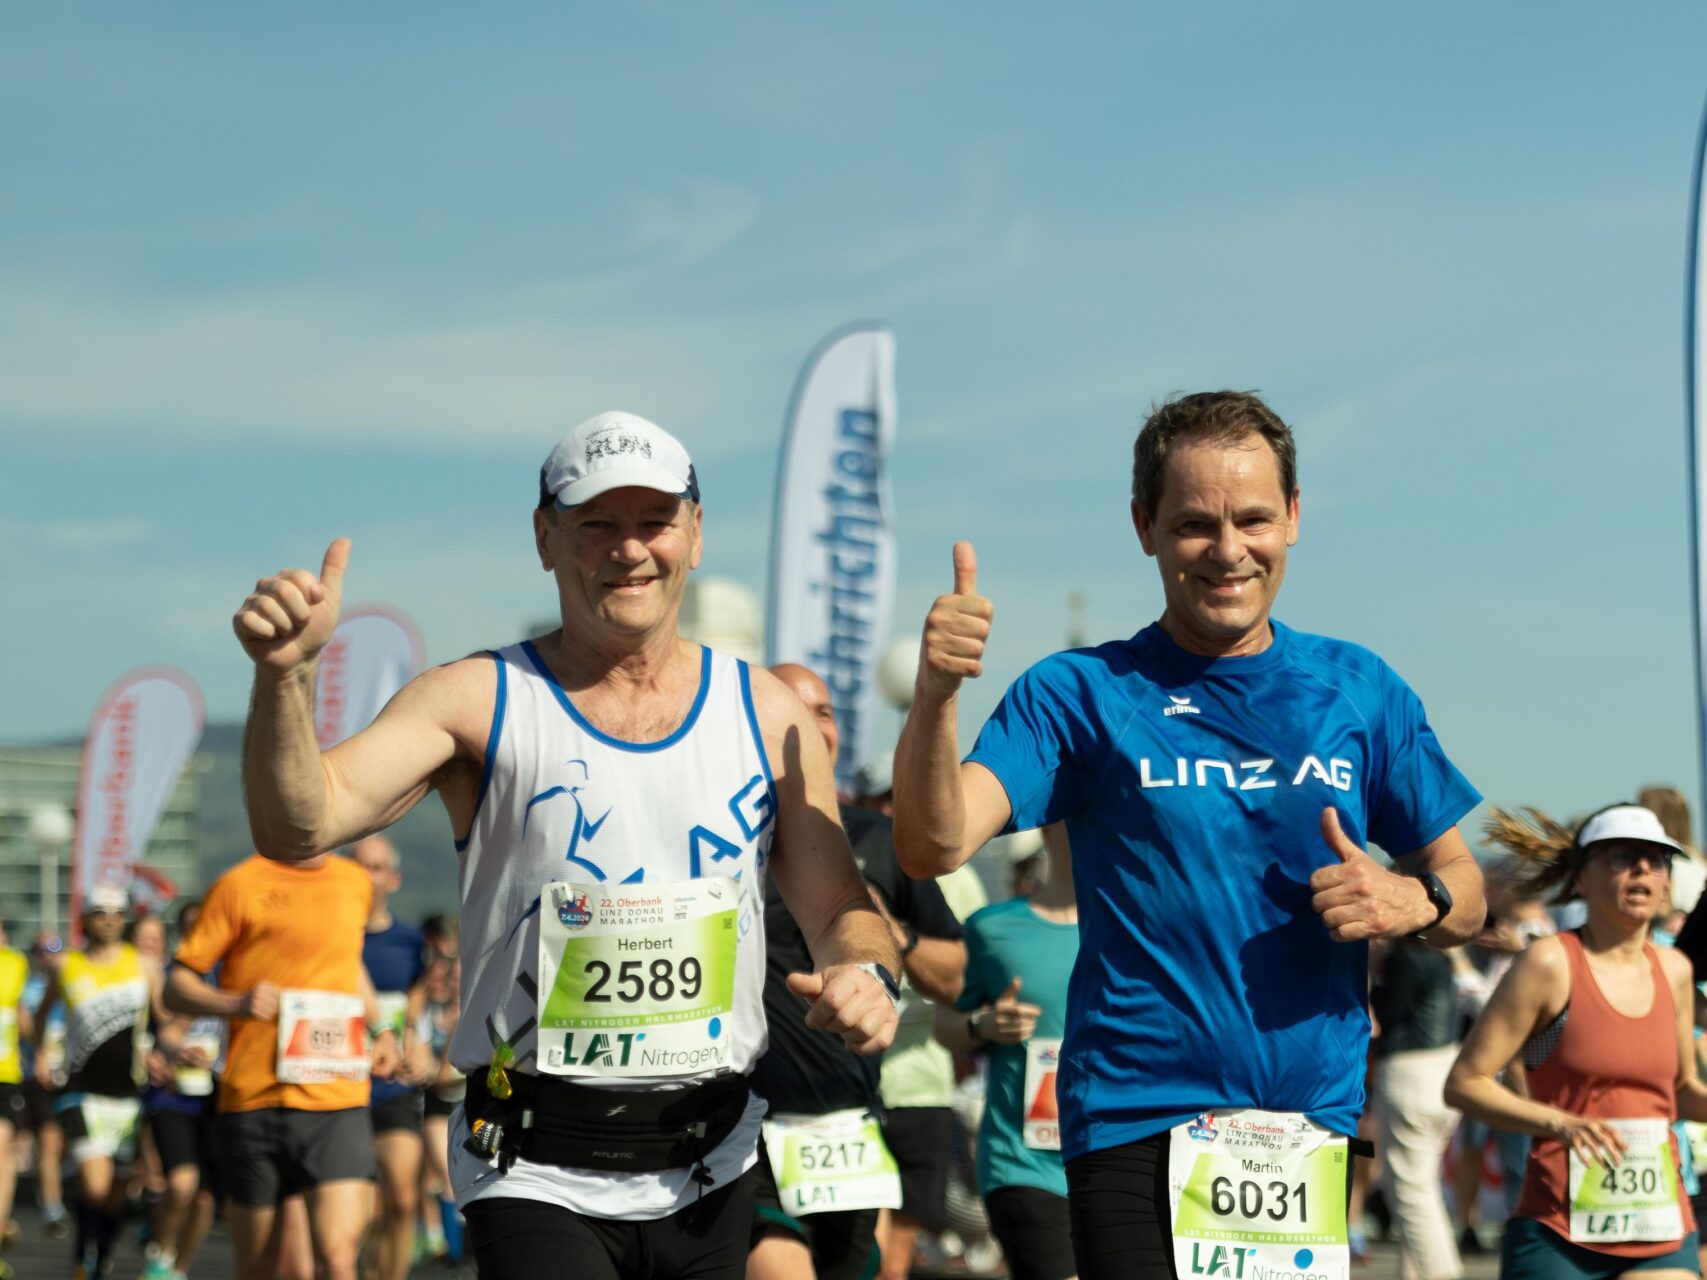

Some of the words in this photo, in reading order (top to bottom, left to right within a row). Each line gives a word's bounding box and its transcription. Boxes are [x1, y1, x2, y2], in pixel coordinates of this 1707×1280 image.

[1292, 755, 1354, 792] AG
[600, 898, 615, 908] 22.
[617, 896, 662, 908] Oberbank
[600, 908, 622, 917] LINZ
[628, 908, 664, 917] DONAU
[600, 916, 664, 926] MARATHON
[617, 936, 674, 951] Herbert
[583, 956, 703, 1004] 2589
[555, 1019, 575, 1027] LAT
[580, 1017, 639, 1027] NITROGEN
[562, 1032, 636, 1067] LAT
[640, 1046, 719, 1069] Nitrogen
[1228, 1119, 1242, 1130] 22.
[1243, 1121, 1286, 1135] Oberbank
[1225, 1128, 1248, 1138] LINZ
[1251, 1132, 1285, 1143] DONAU
[1224, 1137, 1282, 1151] MARATHON
[800, 1142, 866, 1170] 5217
[1241, 1158, 1284, 1174] Martin
[796, 1186, 837, 1208] LAT
[1210, 1175, 1308, 1223] 6031
[1586, 1213, 1632, 1235] LAT
[1191, 1242, 1248, 1280] LAT
